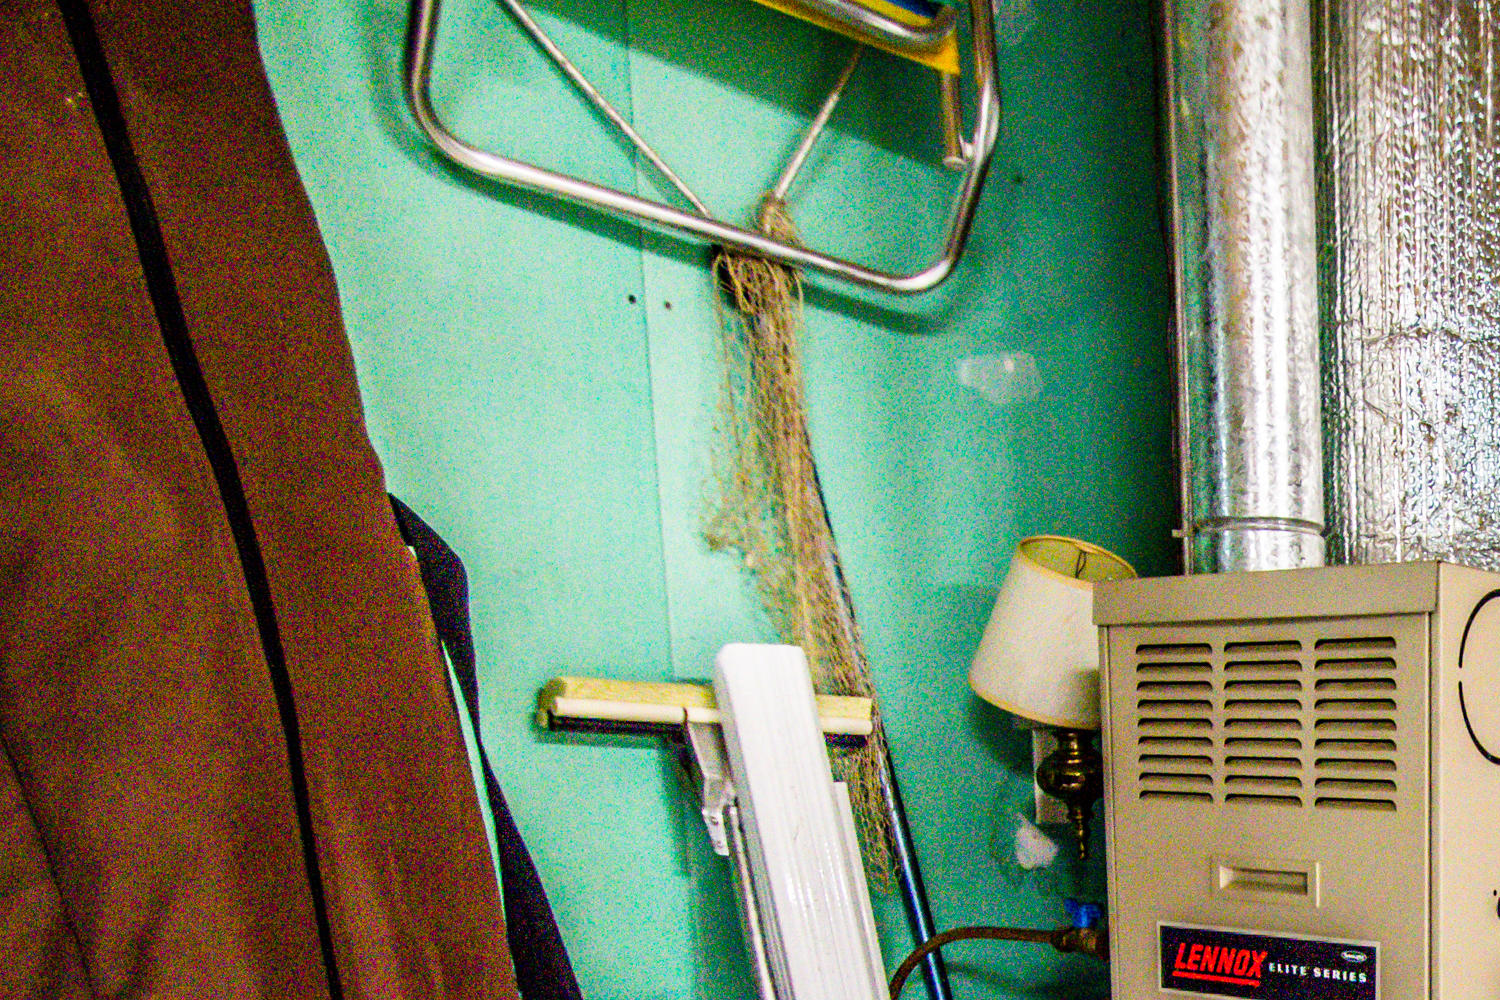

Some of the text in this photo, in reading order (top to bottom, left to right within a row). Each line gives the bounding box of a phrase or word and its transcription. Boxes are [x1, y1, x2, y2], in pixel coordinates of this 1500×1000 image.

[1173, 942, 1368, 983] LENNOX ELITE SERIES
